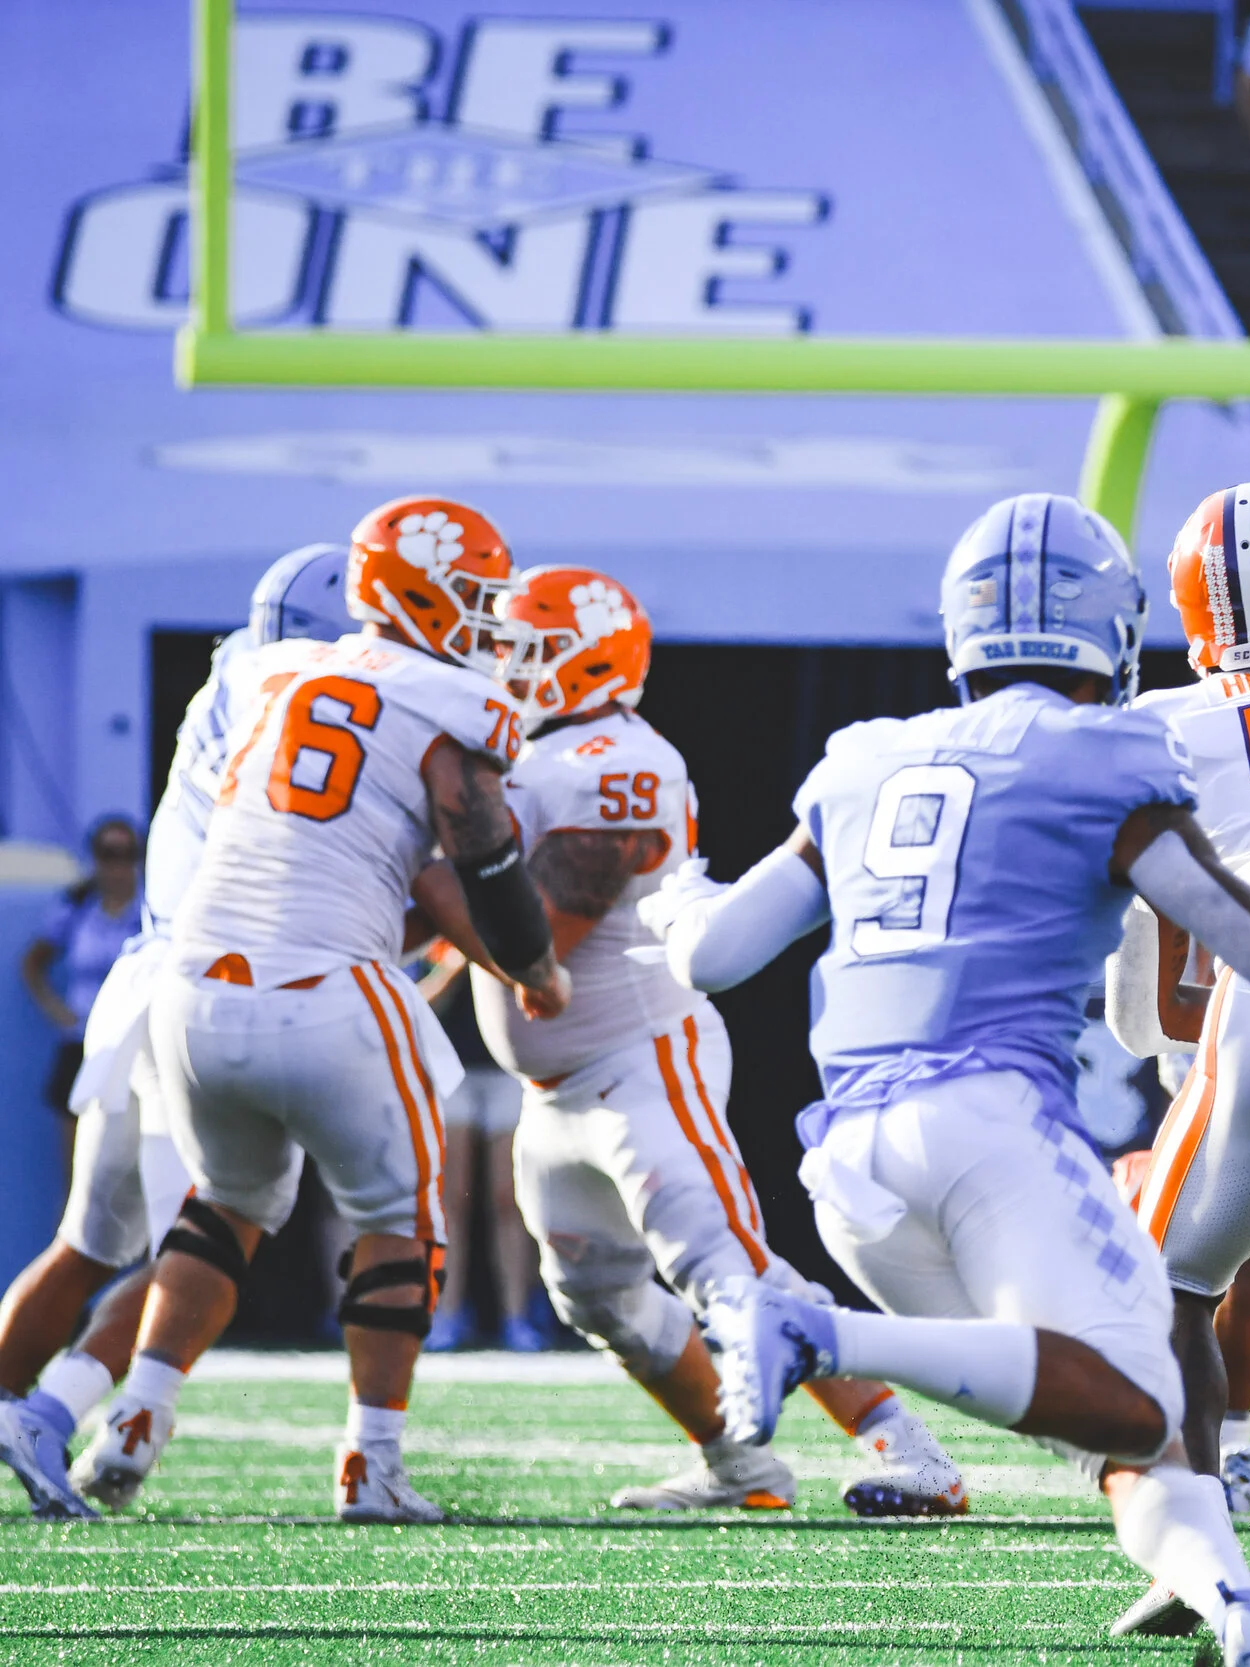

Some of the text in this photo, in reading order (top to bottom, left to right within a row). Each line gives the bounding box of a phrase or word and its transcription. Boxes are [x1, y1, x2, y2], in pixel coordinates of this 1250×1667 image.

[184, 10, 672, 164] BE
[48, 180, 831, 335] ONE
[981, 641, 1017, 660] TAR
[214, 671, 383, 823] 76
[485, 698, 521, 761] 76
[599, 771, 660, 821] 59
[850, 763, 978, 958] 9
